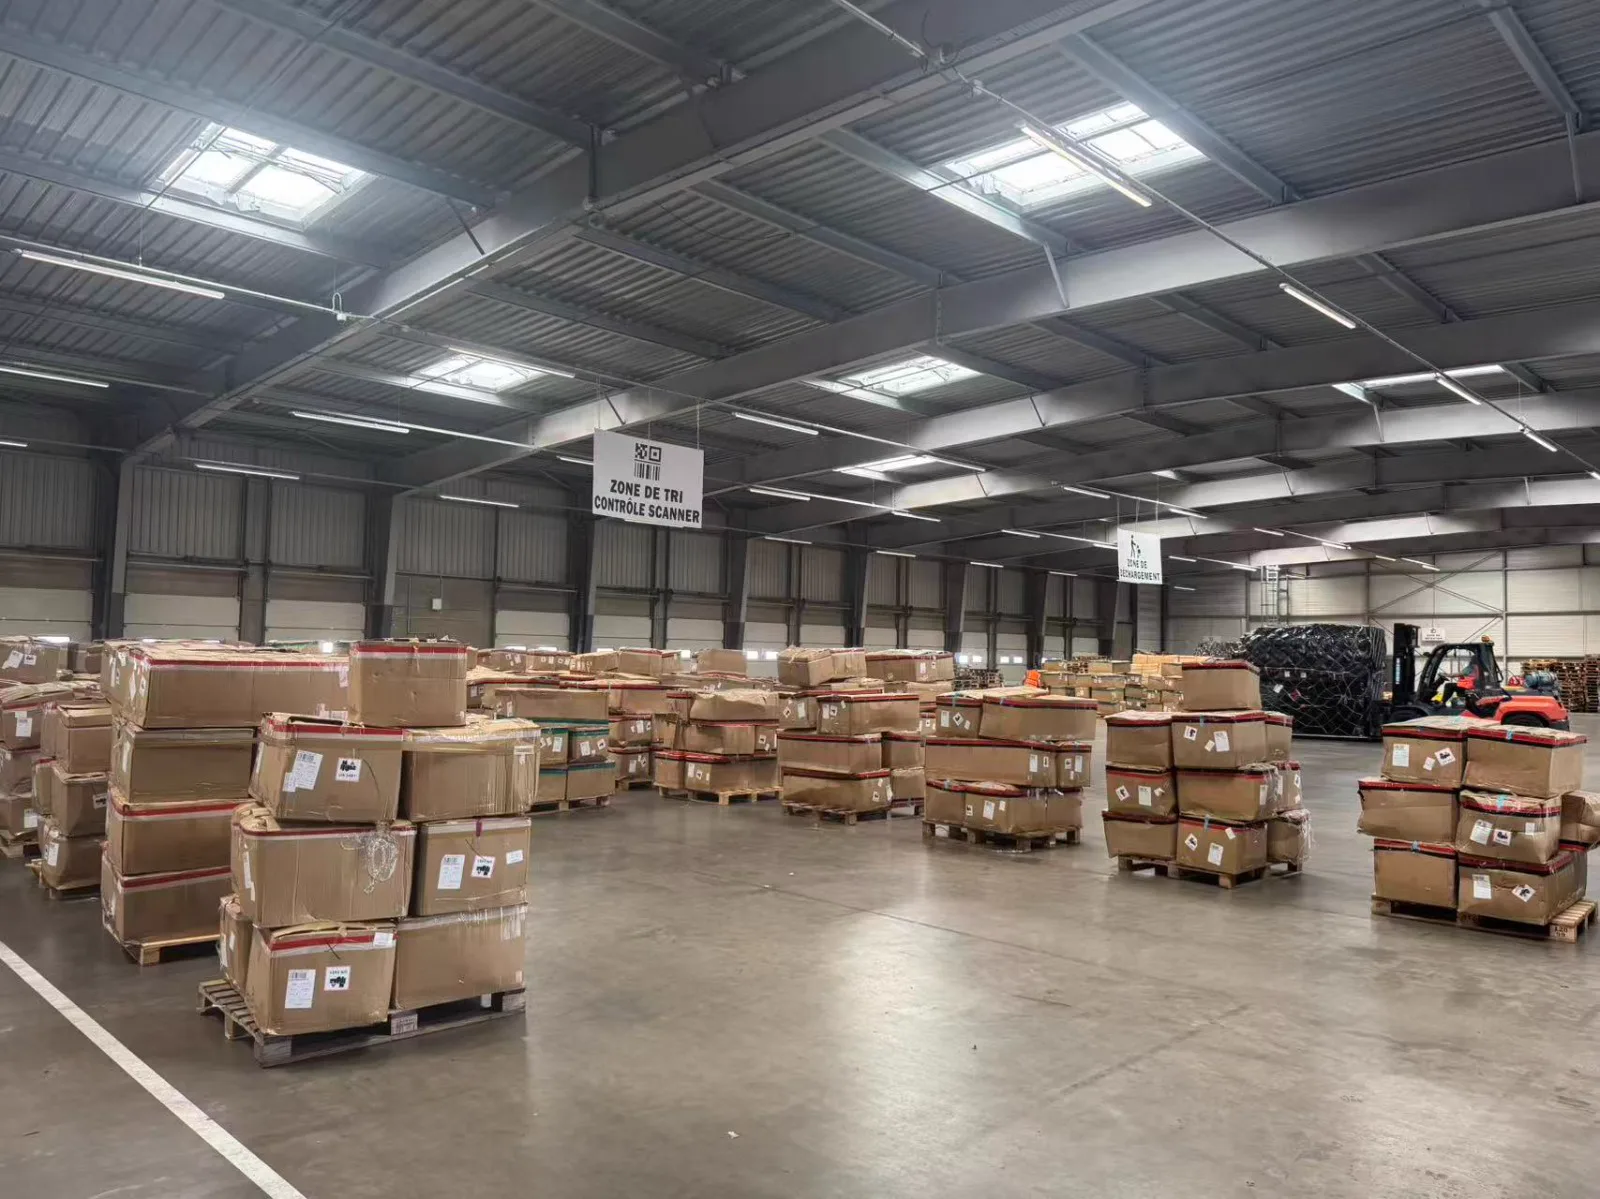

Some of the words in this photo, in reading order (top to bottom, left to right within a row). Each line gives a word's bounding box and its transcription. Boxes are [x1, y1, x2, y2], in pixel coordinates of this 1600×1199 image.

[610, 479, 641, 497] ZONE
[645, 486, 660, 500] DE
[664, 488, 683, 503] TRI
[594, 495, 645, 516] CONTRÔLE
[648, 505, 700, 523] SCANNER
[1127, 559, 1139, 568] ZONE
[1140, 560, 1147, 569] DE
